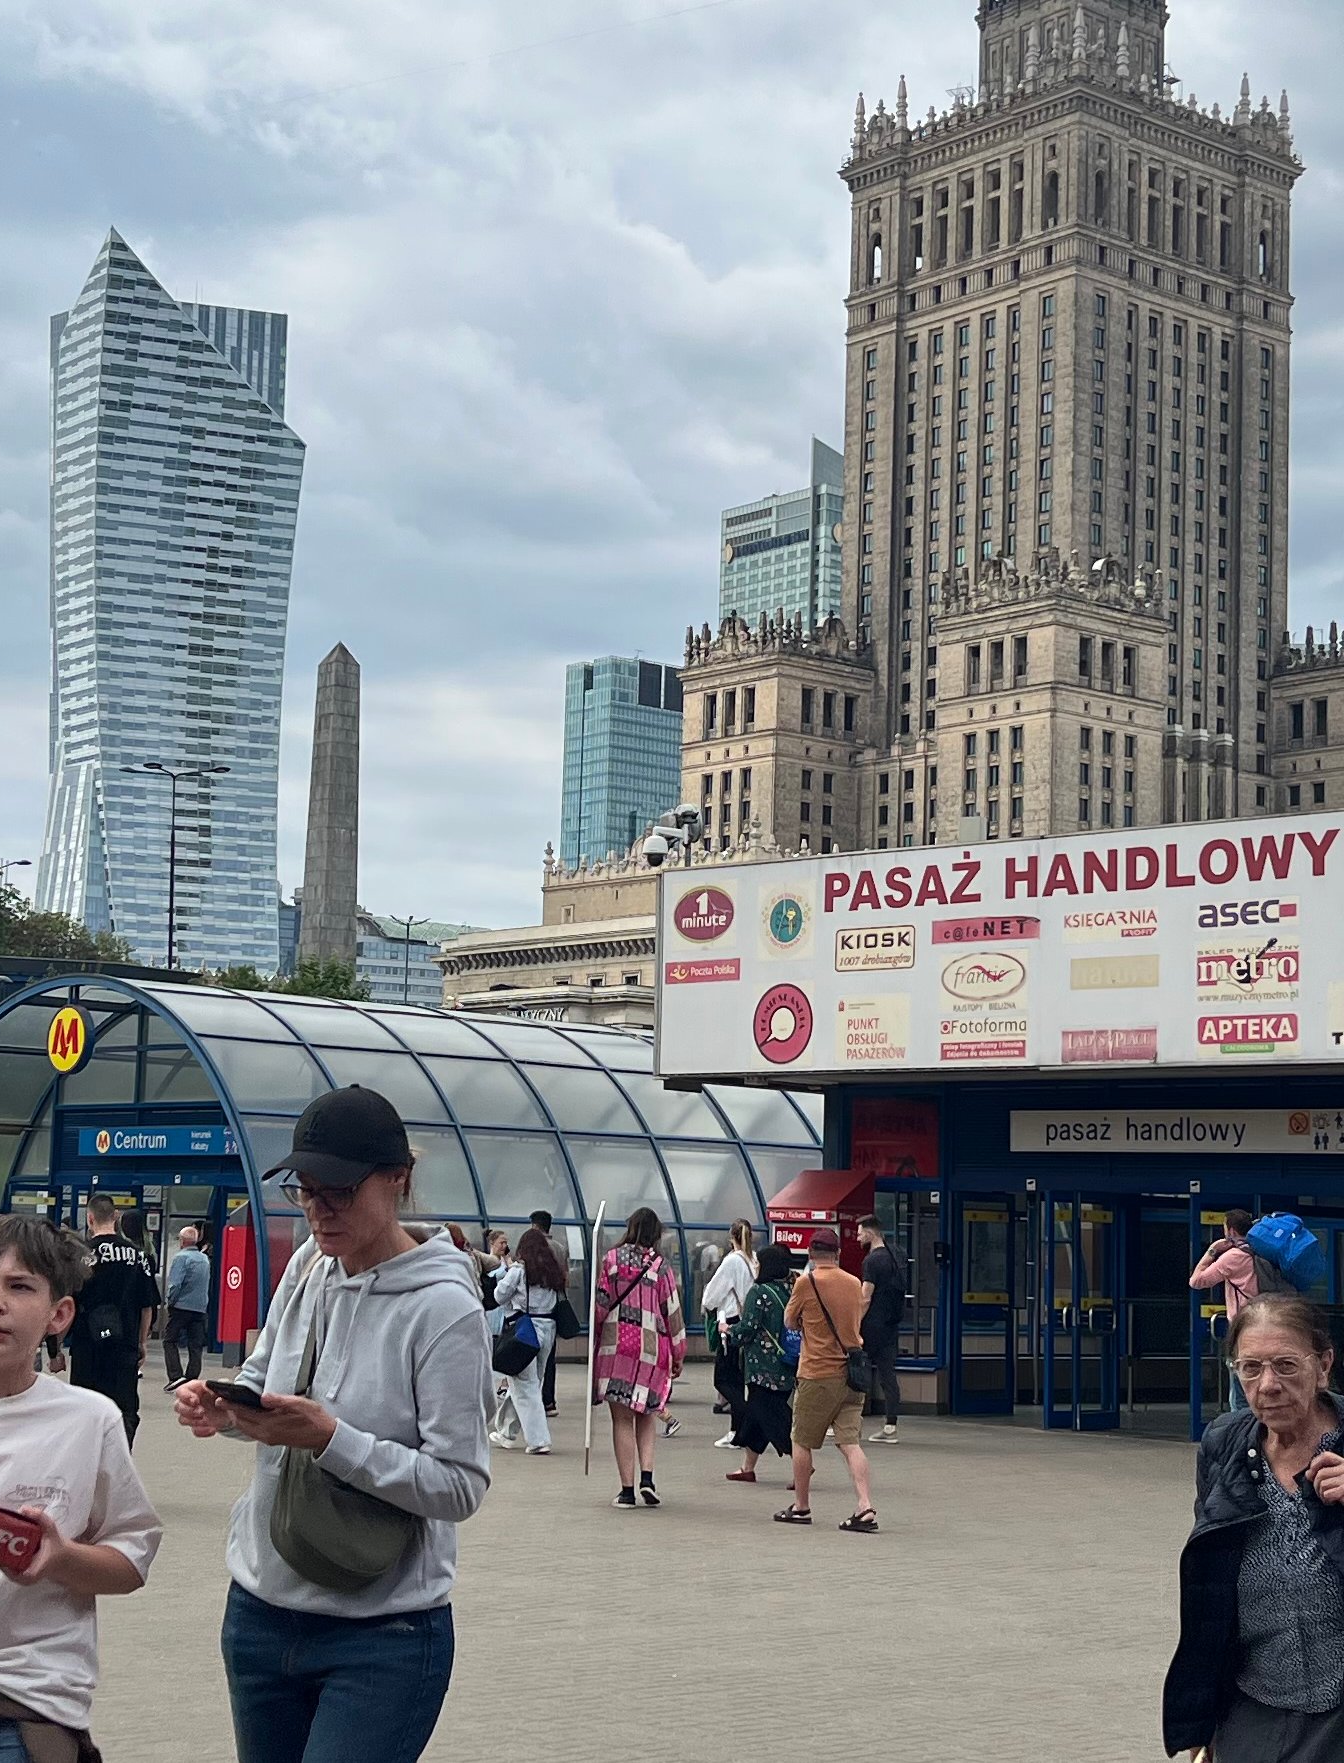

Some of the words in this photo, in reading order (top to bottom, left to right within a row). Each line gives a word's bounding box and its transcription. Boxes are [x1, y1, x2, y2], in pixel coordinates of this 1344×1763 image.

[824, 851, 983, 913] PASAŻ
[1005, 828, 1341, 900] HANDLOWY
[696, 892, 709, 915] 1
[681, 912, 727, 929] minute
[1063, 909, 1158, 929] KSIĘGARNIA
[840, 931, 911, 951] KIOSK
[1122, 927, 1156, 937] PROFIT
[1197, 947, 1234, 956] SKLEP
[690, 965, 713, 977] Poczta
[714, 962, 736, 975] Polska
[1197, 952, 1299, 985] metro
[847, 1017, 880, 1031] PUNKT
[950, 1017, 1027, 1035] Fotoforma
[1202, 1016, 1294, 1041] APTEKA
[846, 1032, 889, 1046] OBSŁUGI
[846, 1043, 906, 1060] PASAŻERÓW
[113, 1131, 167, 1150] Centrum
[1045, 1116, 1112, 1146] pasaż
[1126, 1116, 1246, 1148] handlowy
[775, 1230, 803, 1245] Bilety
